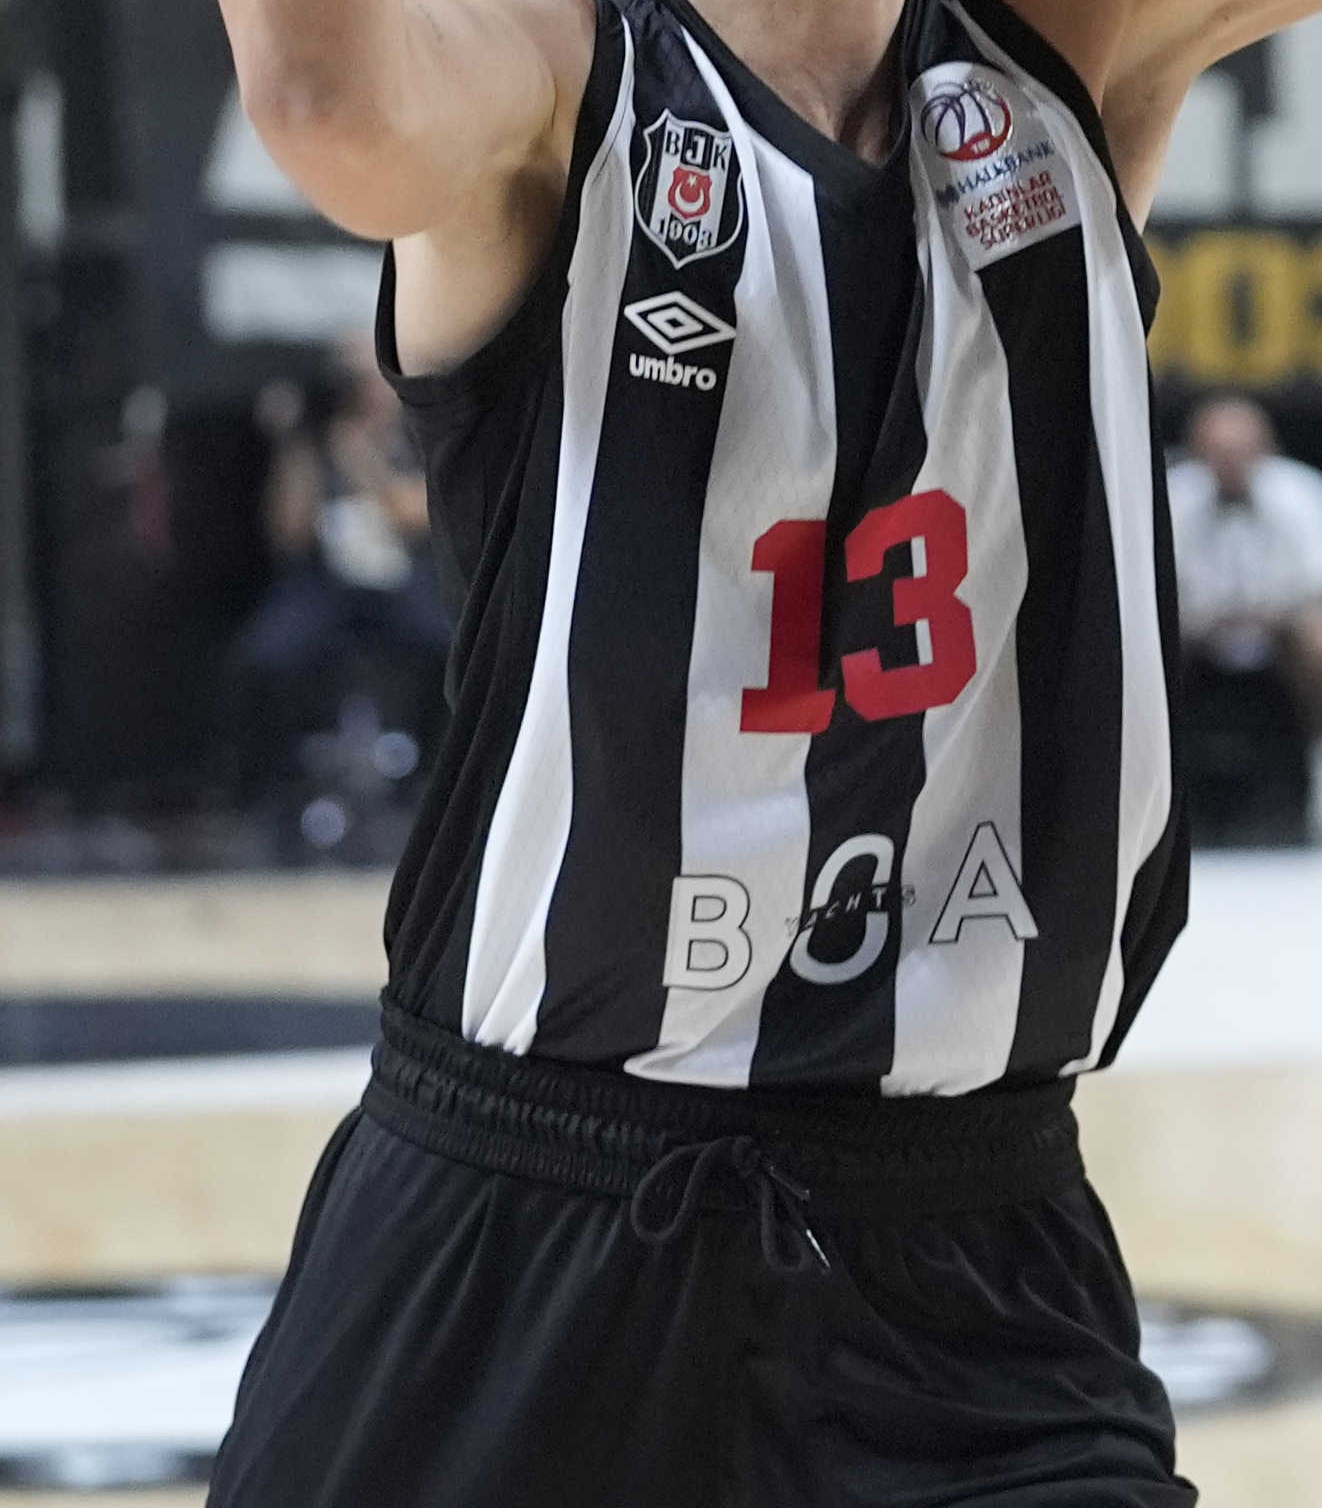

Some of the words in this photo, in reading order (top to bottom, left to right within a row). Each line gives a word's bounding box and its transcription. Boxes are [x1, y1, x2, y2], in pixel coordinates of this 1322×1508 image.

[664, 130, 727, 171] BJK
[957, 142, 1056, 194] HALKBANK
[656, 217, 714, 249] 1903
[629, 353, 717, 391] umbro
[740, 488, 977, 734] 13
[662, 821, 1039, 991] BOA
